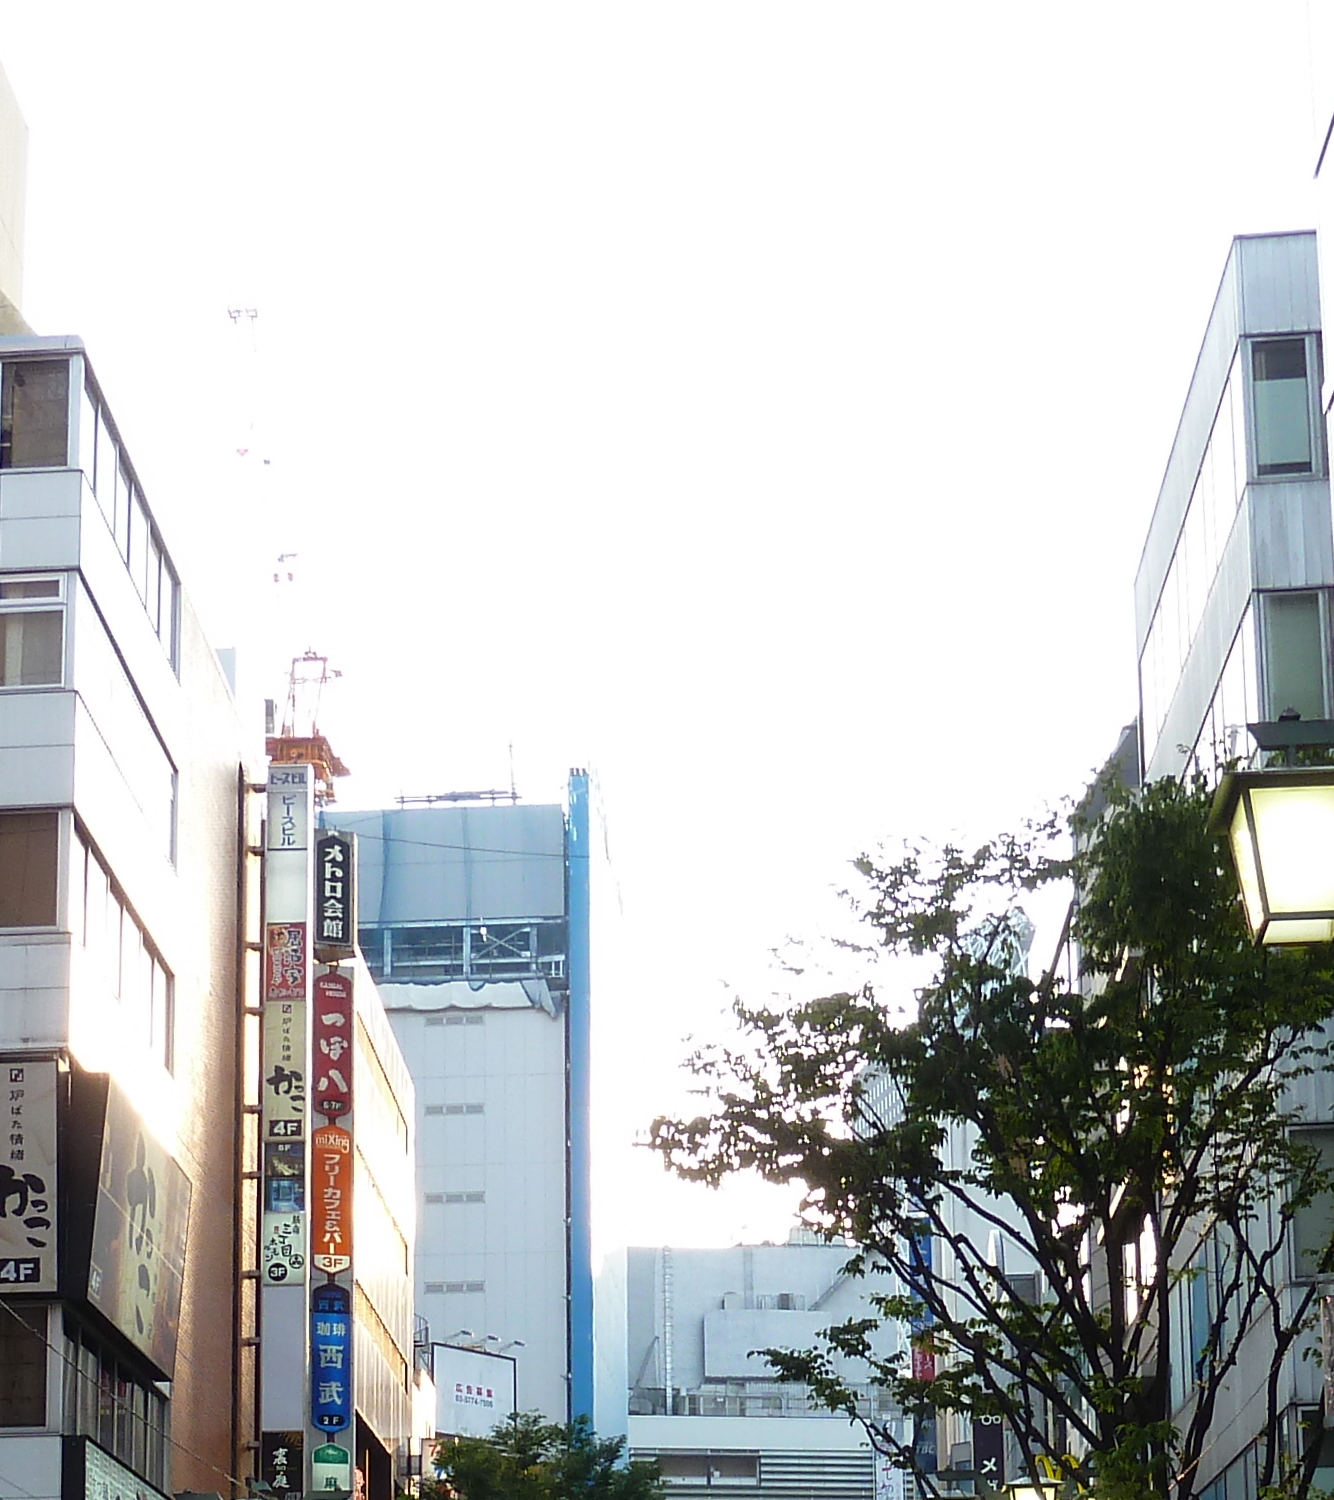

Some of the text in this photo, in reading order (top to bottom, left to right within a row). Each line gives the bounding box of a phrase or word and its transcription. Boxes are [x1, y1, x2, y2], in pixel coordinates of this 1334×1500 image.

[323, 846, 345, 939] メトロ会館
[317, 1011, 348, 1092] つぼ八
[273, 1121, 298, 1136] 4F
[0, 1261, 35, 1282] 4F
[323, 1256, 344, 1268] 3F
[318, 1344, 344, 1406] 西武
[322, 1415, 341, 1426] 2F
